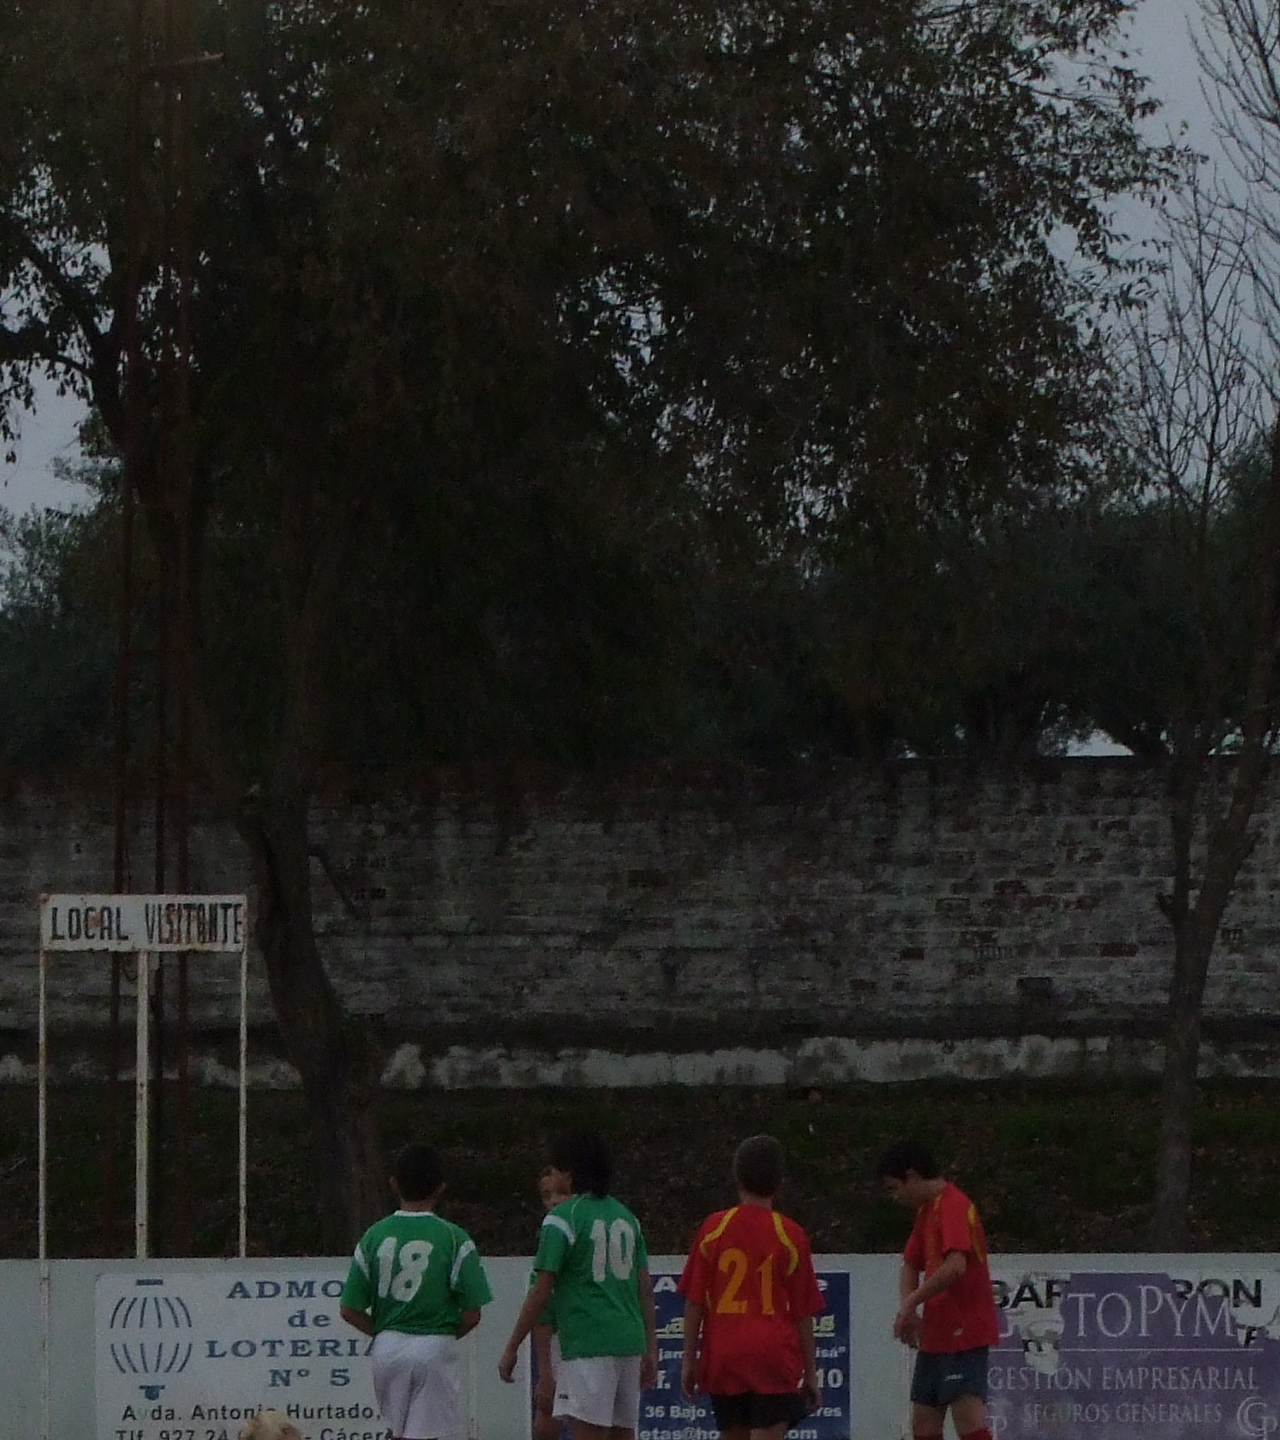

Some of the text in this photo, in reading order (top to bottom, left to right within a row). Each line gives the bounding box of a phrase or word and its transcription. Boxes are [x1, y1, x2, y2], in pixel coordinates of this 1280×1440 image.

[51, 903, 243, 944] LOCAL VISITANTE
[589, 1217, 636, 1283] 10
[375, 1236, 433, 1302] 18
[716, 1247, 775, 1316] 21
[288, 1309, 331, 1328] de
[330, 1368, 351, 1388] 5
[1102, 1366, 1259, 1391] EMPRESARIAL
[286, 1403, 381, 1425] Hurtado,
[645, 1404, 707, 1422] 36 Bajo
[1022, 1403, 1222, 1424] SEGUROS GENERALES
